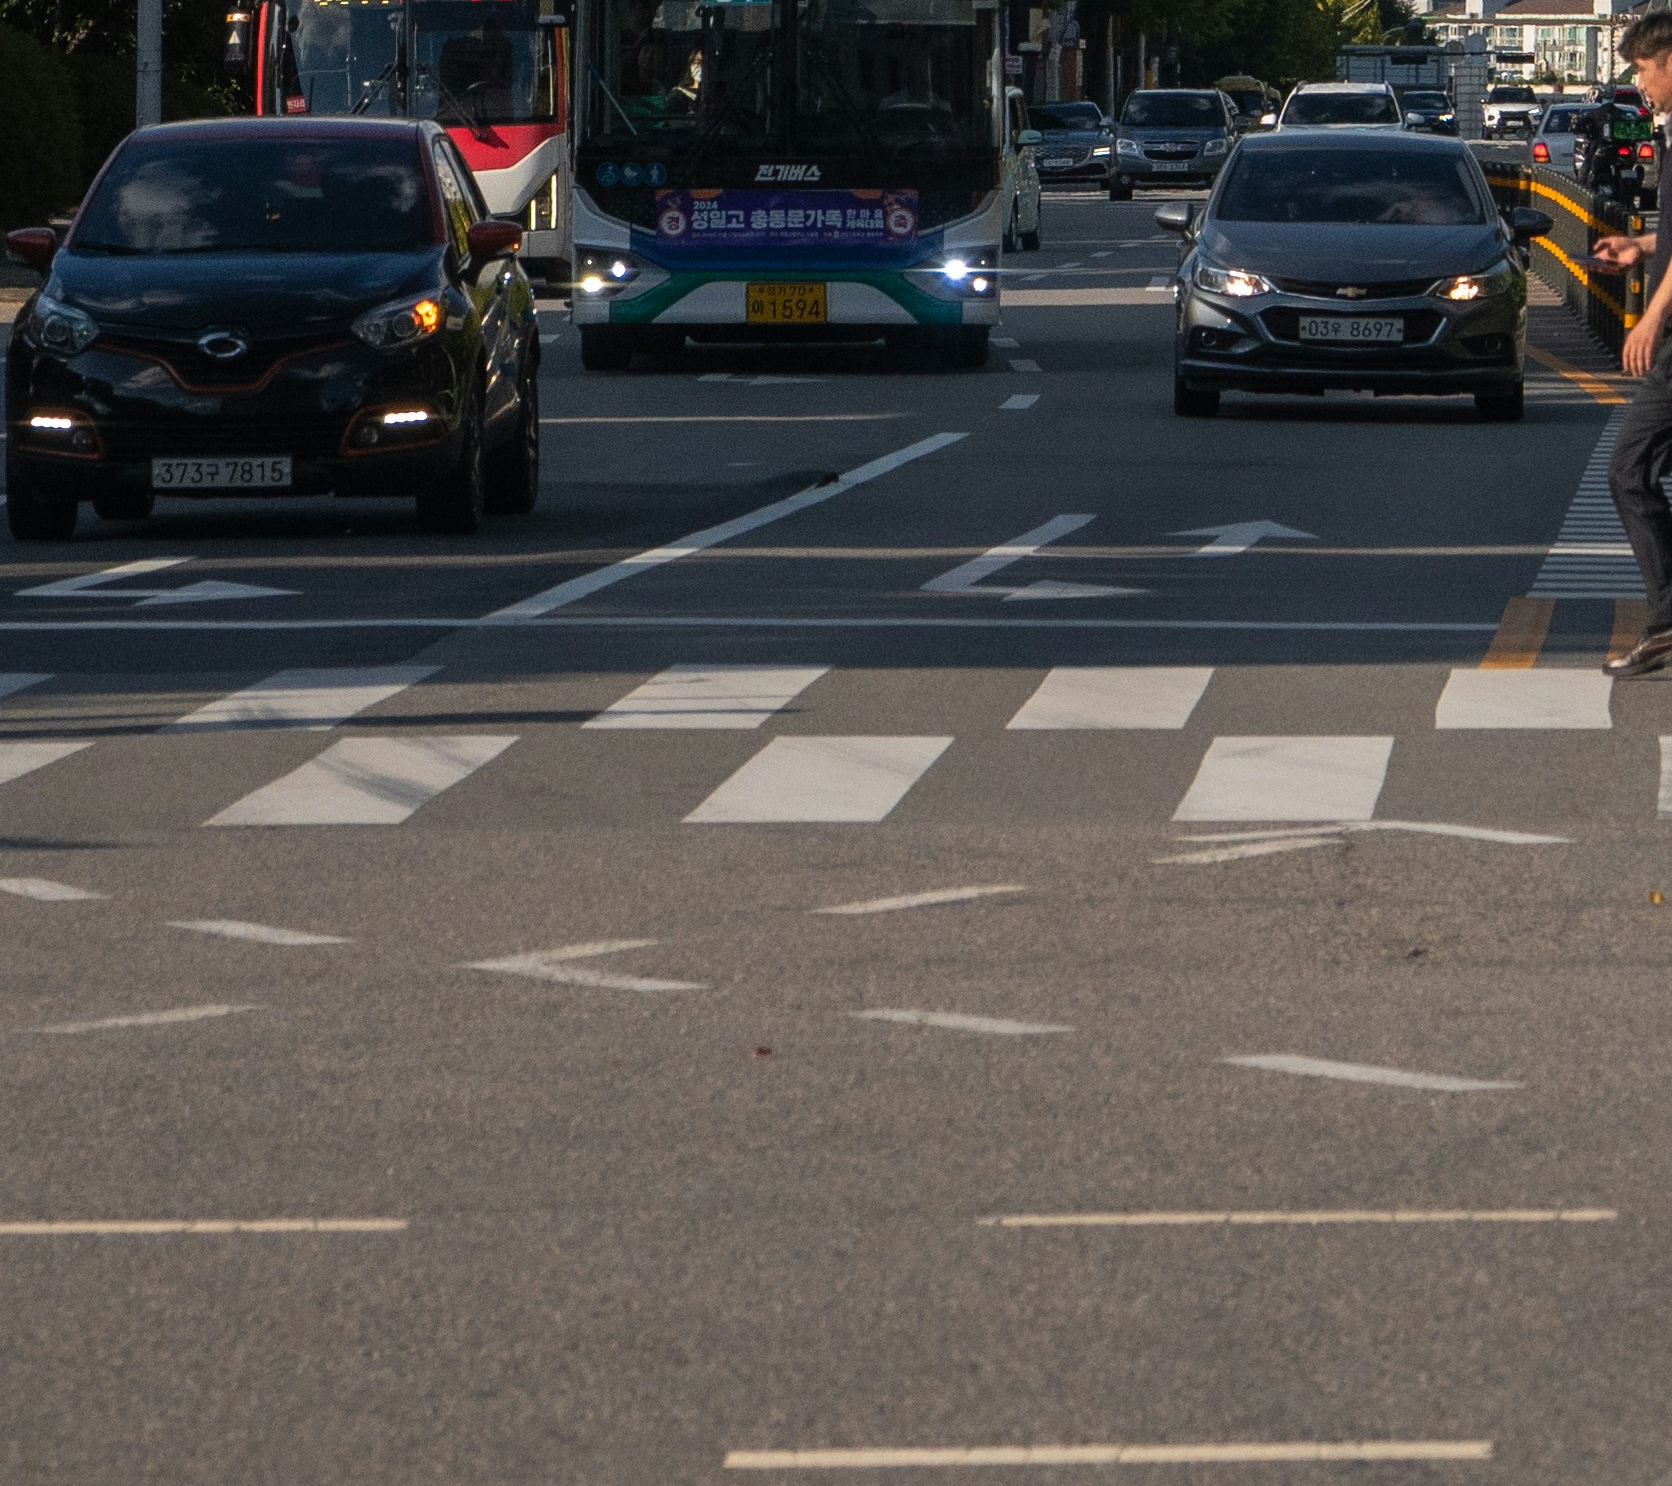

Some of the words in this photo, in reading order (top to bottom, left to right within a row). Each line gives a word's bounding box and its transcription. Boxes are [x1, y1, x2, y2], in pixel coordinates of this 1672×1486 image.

[754, 164, 822, 182] 전기버스
[693, 200, 719, 210] 2024
[690, 209, 746, 230] 성일고
[750, 209, 843, 230] 총동문가족
[1308, 320, 1341, 337] 03우
[1350, 320, 1395, 338] 8697
[161, 461, 220, 484] 373구
[224, 460, 284, 483] 7815
